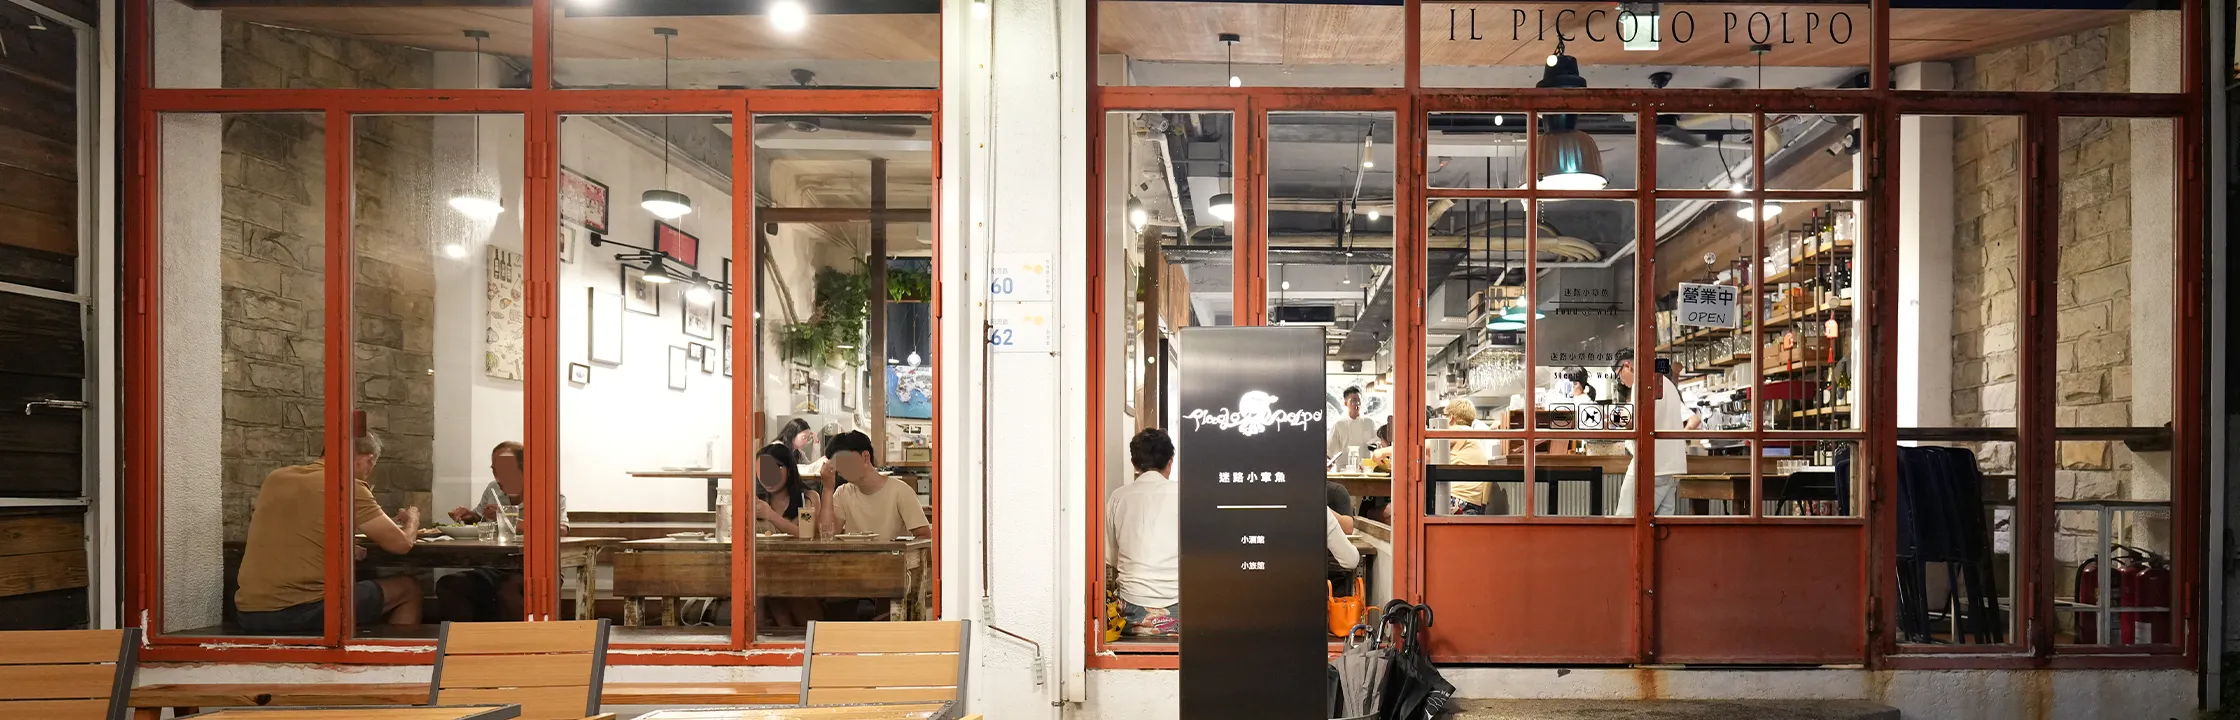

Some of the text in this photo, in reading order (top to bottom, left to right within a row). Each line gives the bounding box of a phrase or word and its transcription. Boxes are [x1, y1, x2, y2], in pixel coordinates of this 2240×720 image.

[1448, 8, 1853, 45] IL PICCOLO POLPO
[991, 277, 1013, 295] 60
[1683, 286, 1733, 306] 營業中
[1688, 312, 1726, 324] OPEN
[991, 329, 1014, 346] 62
[1219, 472, 1286, 483] 迷路小章魚
